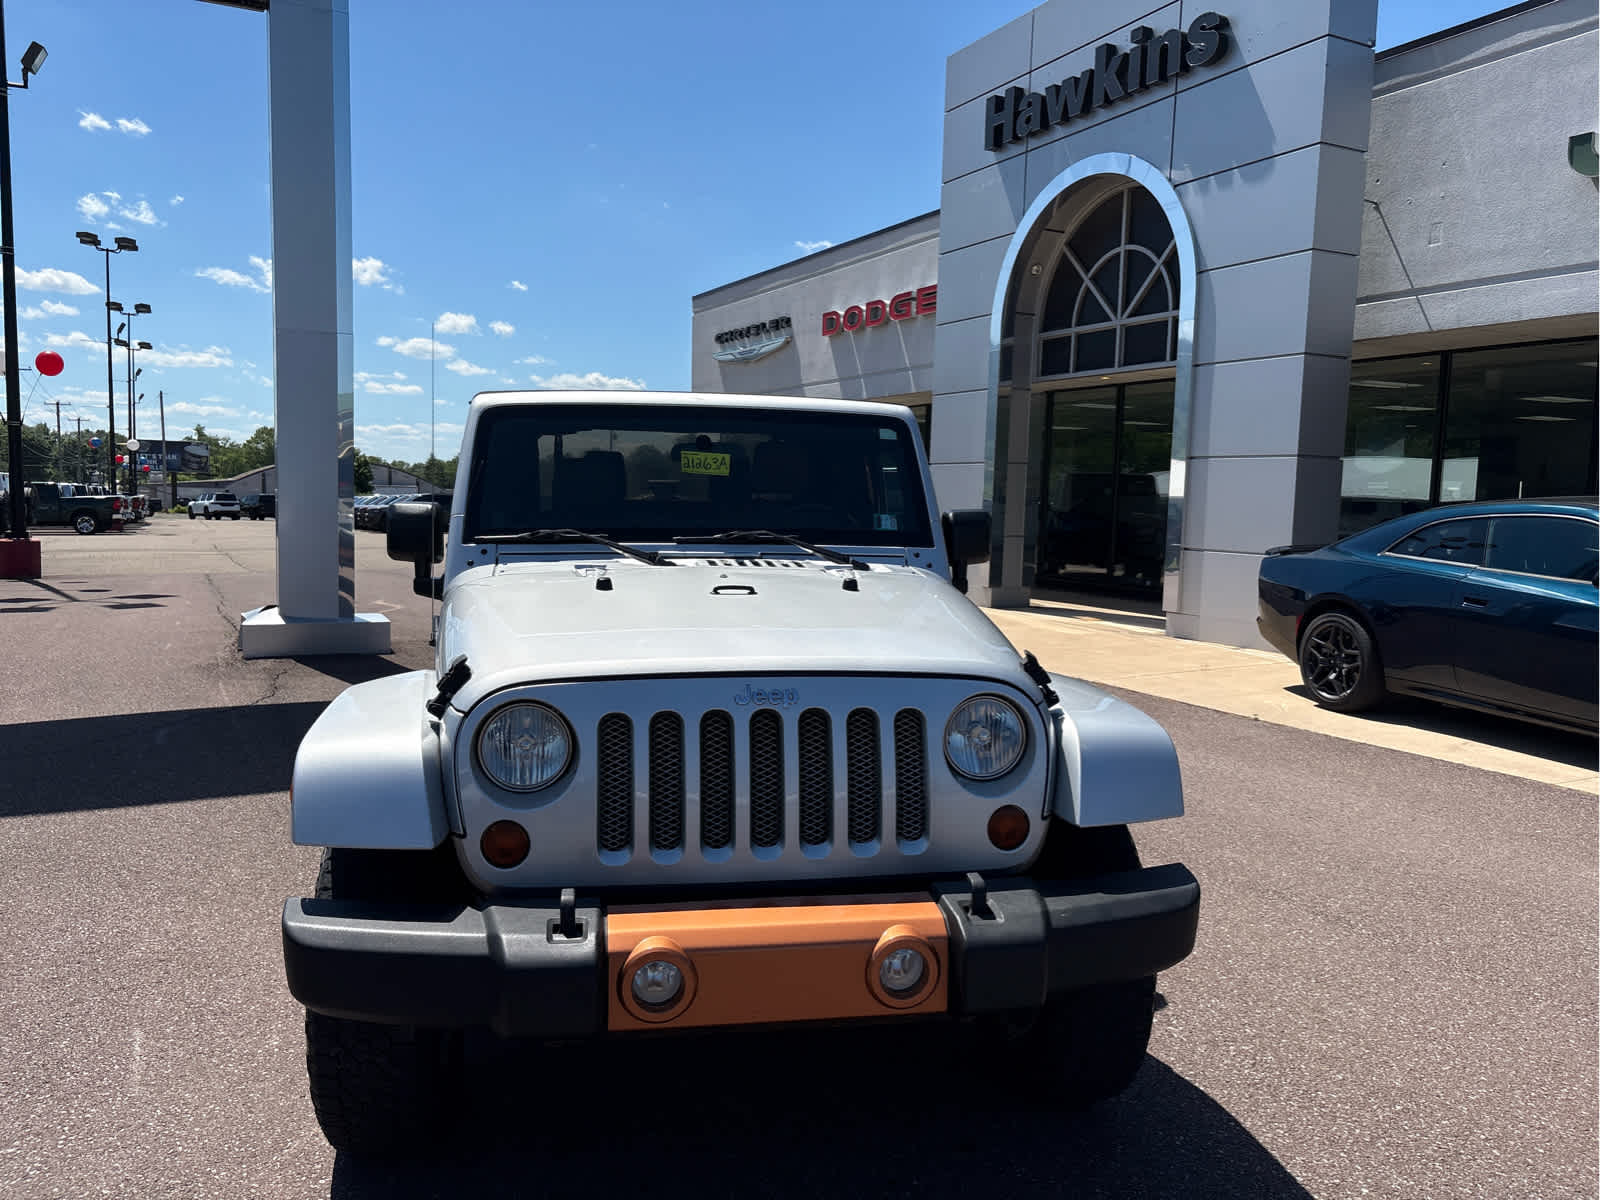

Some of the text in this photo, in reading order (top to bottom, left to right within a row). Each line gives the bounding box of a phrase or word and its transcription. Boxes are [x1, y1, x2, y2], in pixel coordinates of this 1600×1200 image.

[984, 11, 1231, 151] Hawkins
[822, 284, 938, 336] DODGE
[683, 455, 729, 471] 21263A
[734, 683, 801, 709] Jeep
